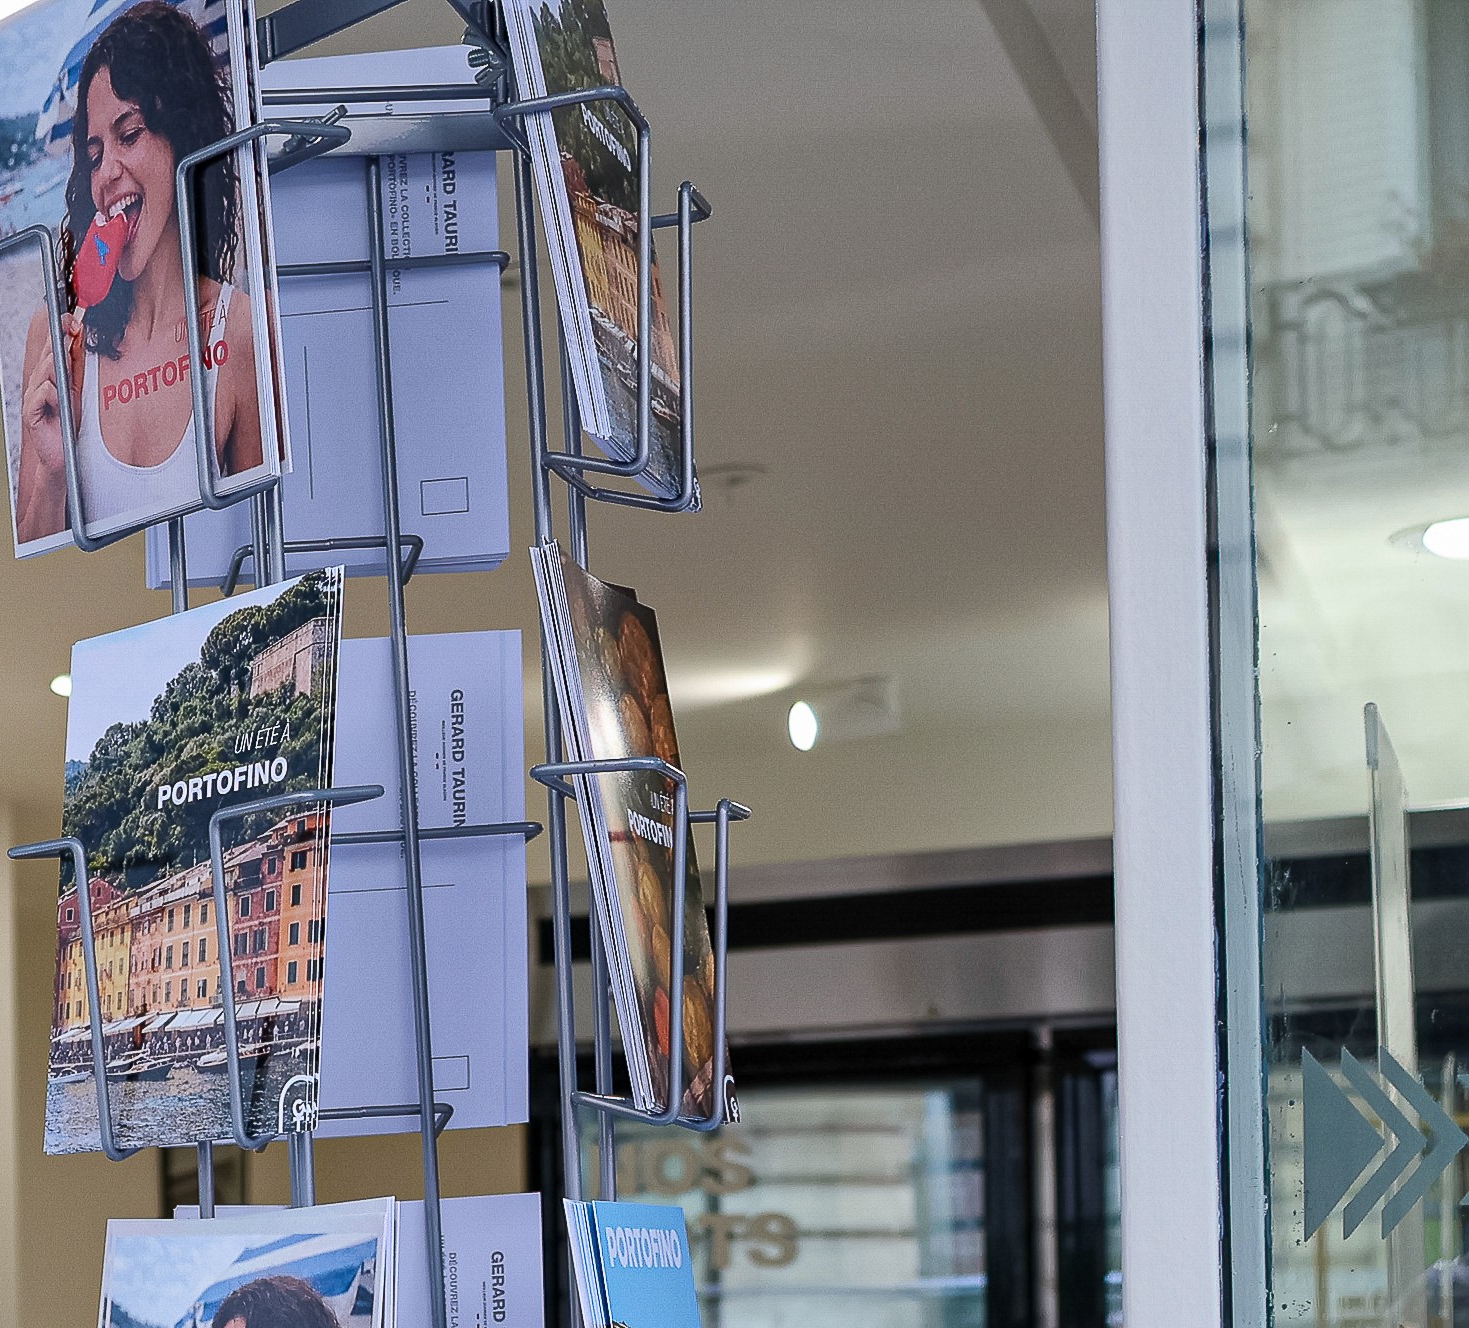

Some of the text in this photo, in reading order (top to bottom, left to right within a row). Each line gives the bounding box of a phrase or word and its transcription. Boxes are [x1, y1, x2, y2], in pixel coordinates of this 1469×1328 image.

[400, 205, 411, 257] COLLECTI
[444, 200, 459, 256] TAURI
[103, 340, 229, 411] PORTOFNO
[234, 717, 291, 754] UN ÉTÉ À
[450, 689, 465, 763] GERARD
[157, 756, 288, 810] PORTOFINO
[626, 808, 674, 849] PORTOFIN
[605, 1226, 682, 1270] PORTOFINO
[448, 1252, 459, 1313] DÉCOUVREZ
[491, 1251, 505, 1323] GERARD
[451, 1315, 460, 1328] LA
